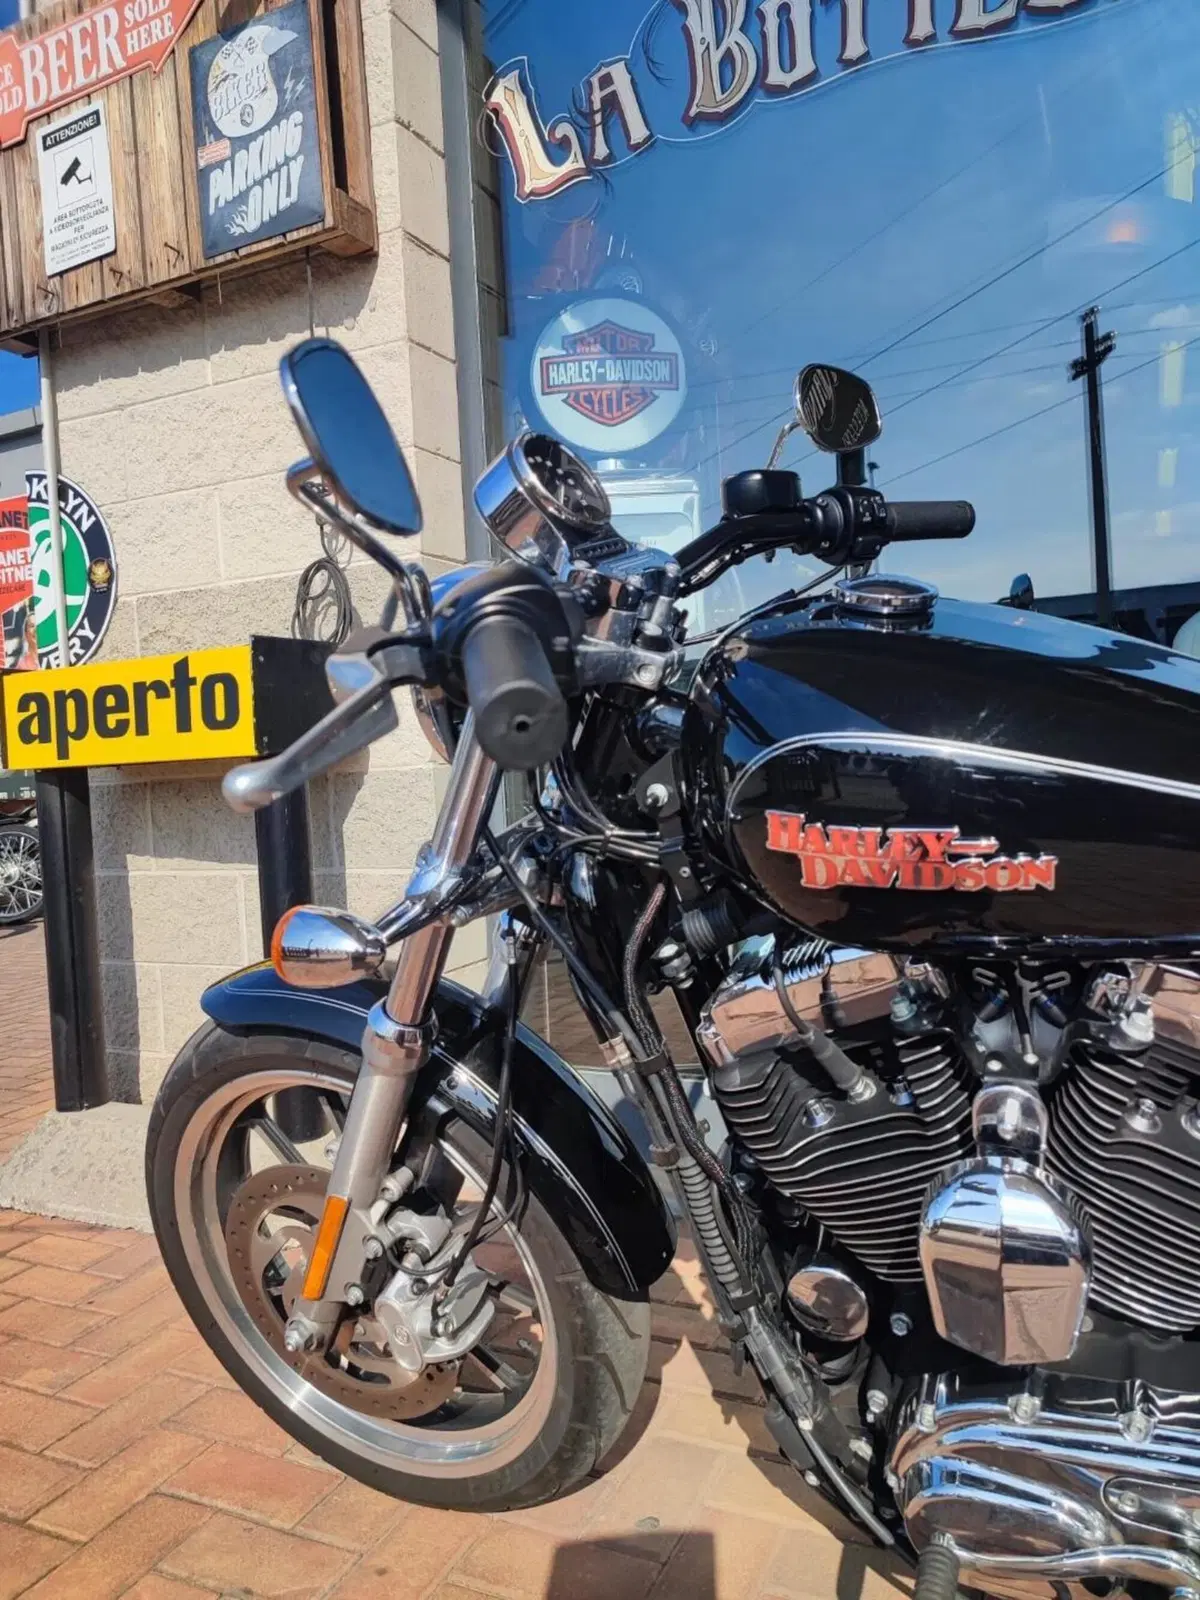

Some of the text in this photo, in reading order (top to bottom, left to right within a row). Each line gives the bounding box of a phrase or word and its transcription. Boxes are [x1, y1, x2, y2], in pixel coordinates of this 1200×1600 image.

[20, 7, 126, 112] BEER
[124, 11, 174, 56] HERE
[45, 114, 97, 147] ATTENZIONE!
[209, 111, 304, 215] PARKING
[485, 60, 653, 198] LA
[246, 154, 305, 233] ONLY
[549, 359, 670, 386] HARLEY-DAVIDSON
[17, 655, 241, 760] aperto
[800, 853, 1059, 892] DAVIDSON
